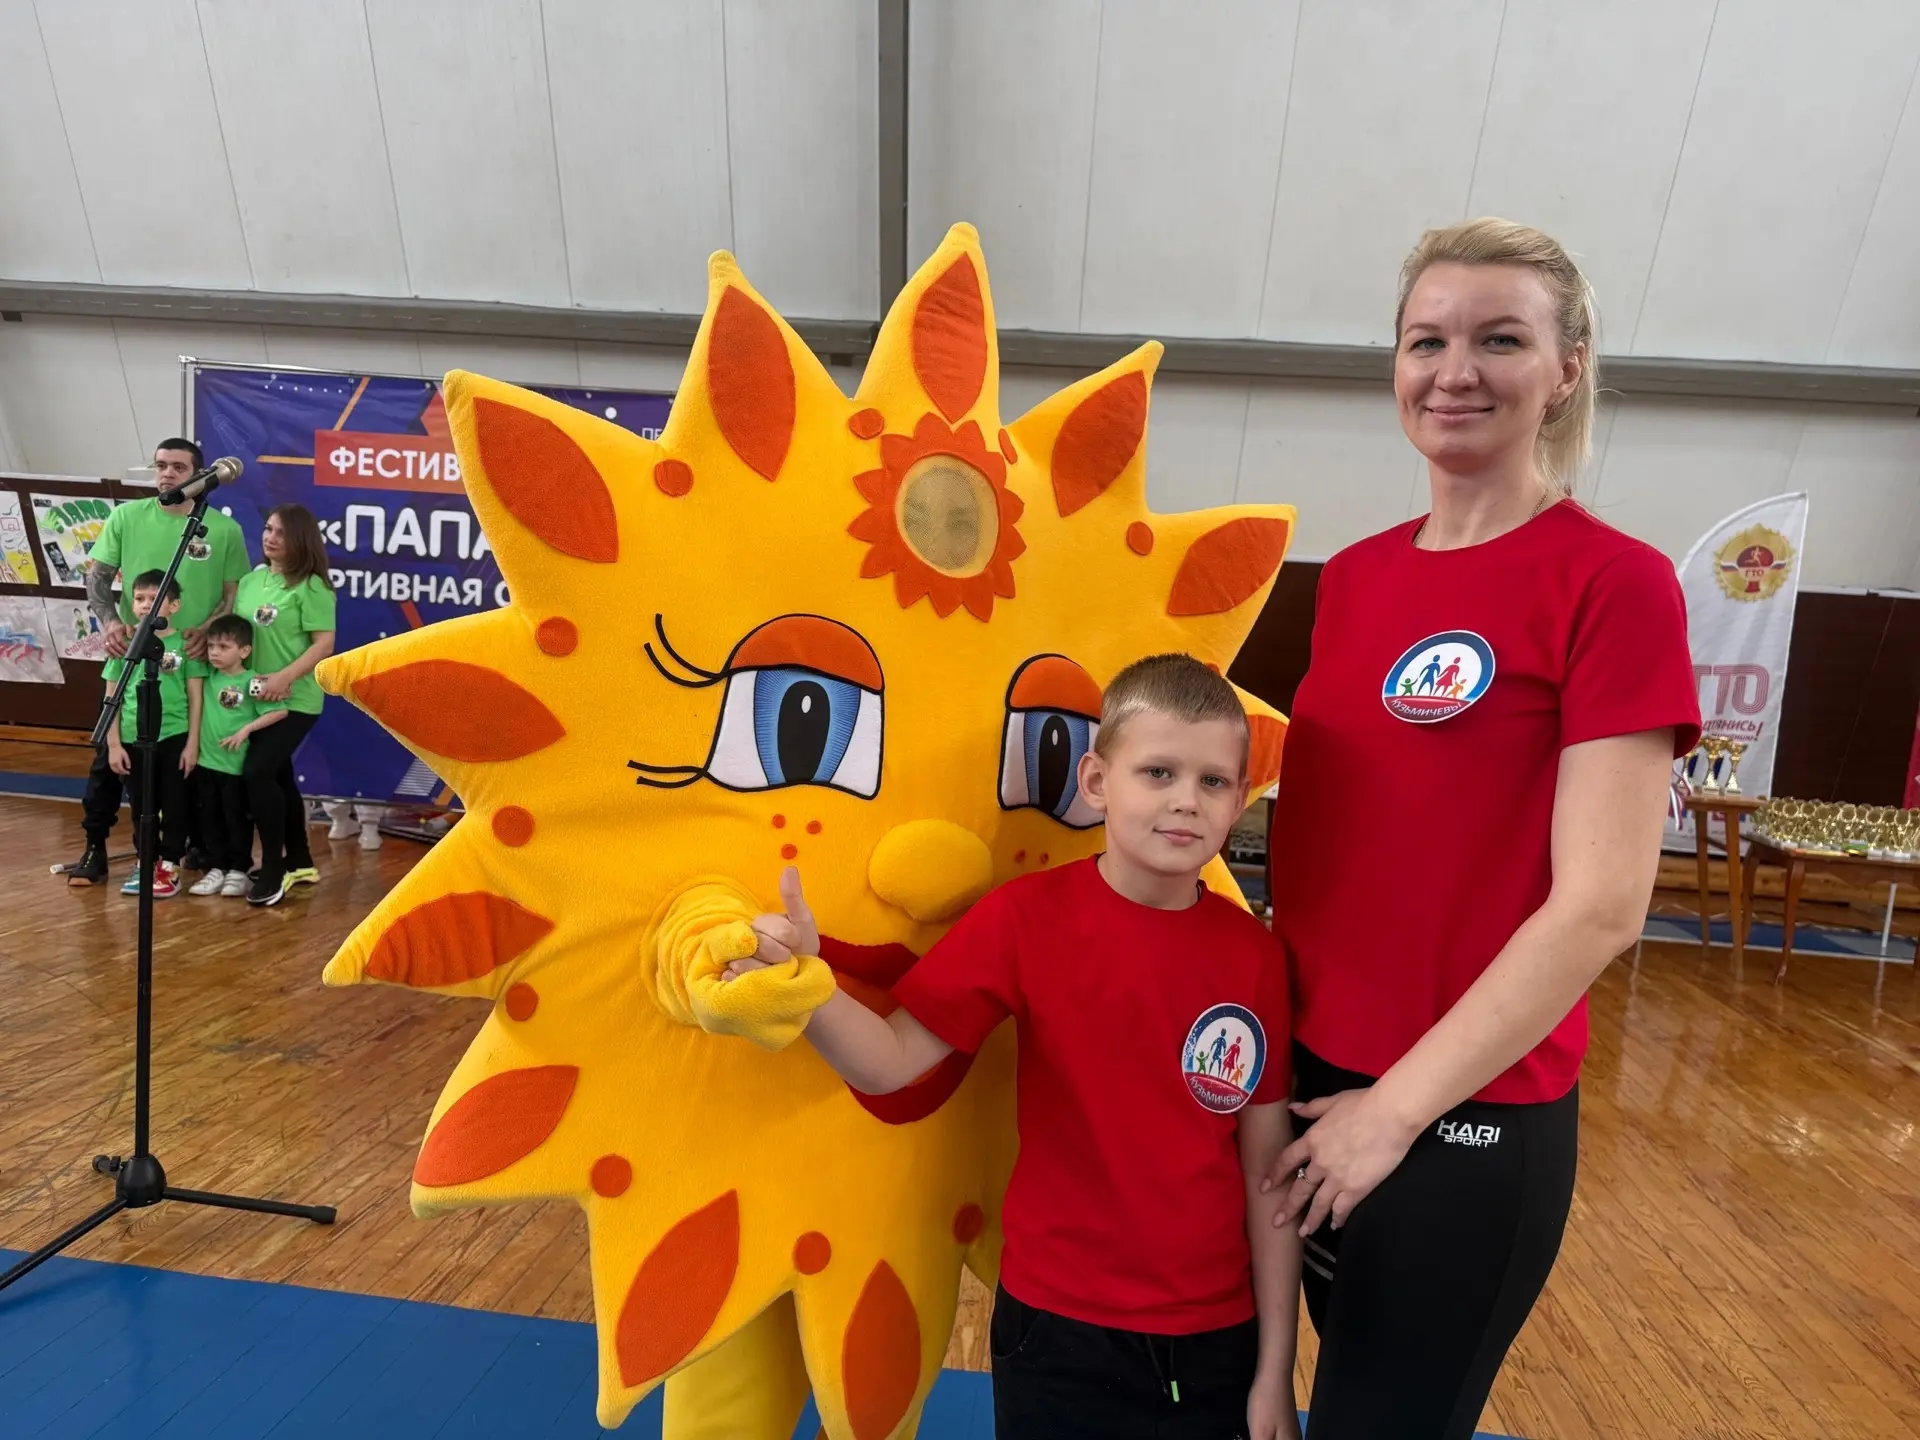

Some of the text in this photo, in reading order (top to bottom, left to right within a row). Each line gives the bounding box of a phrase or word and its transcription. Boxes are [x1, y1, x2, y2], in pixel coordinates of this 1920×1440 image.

[329, 446, 461, 482] ФЕСТИВ
[1437, 1119, 1501, 1143] KARI
[1444, 1135, 1489, 1148] SPORT
